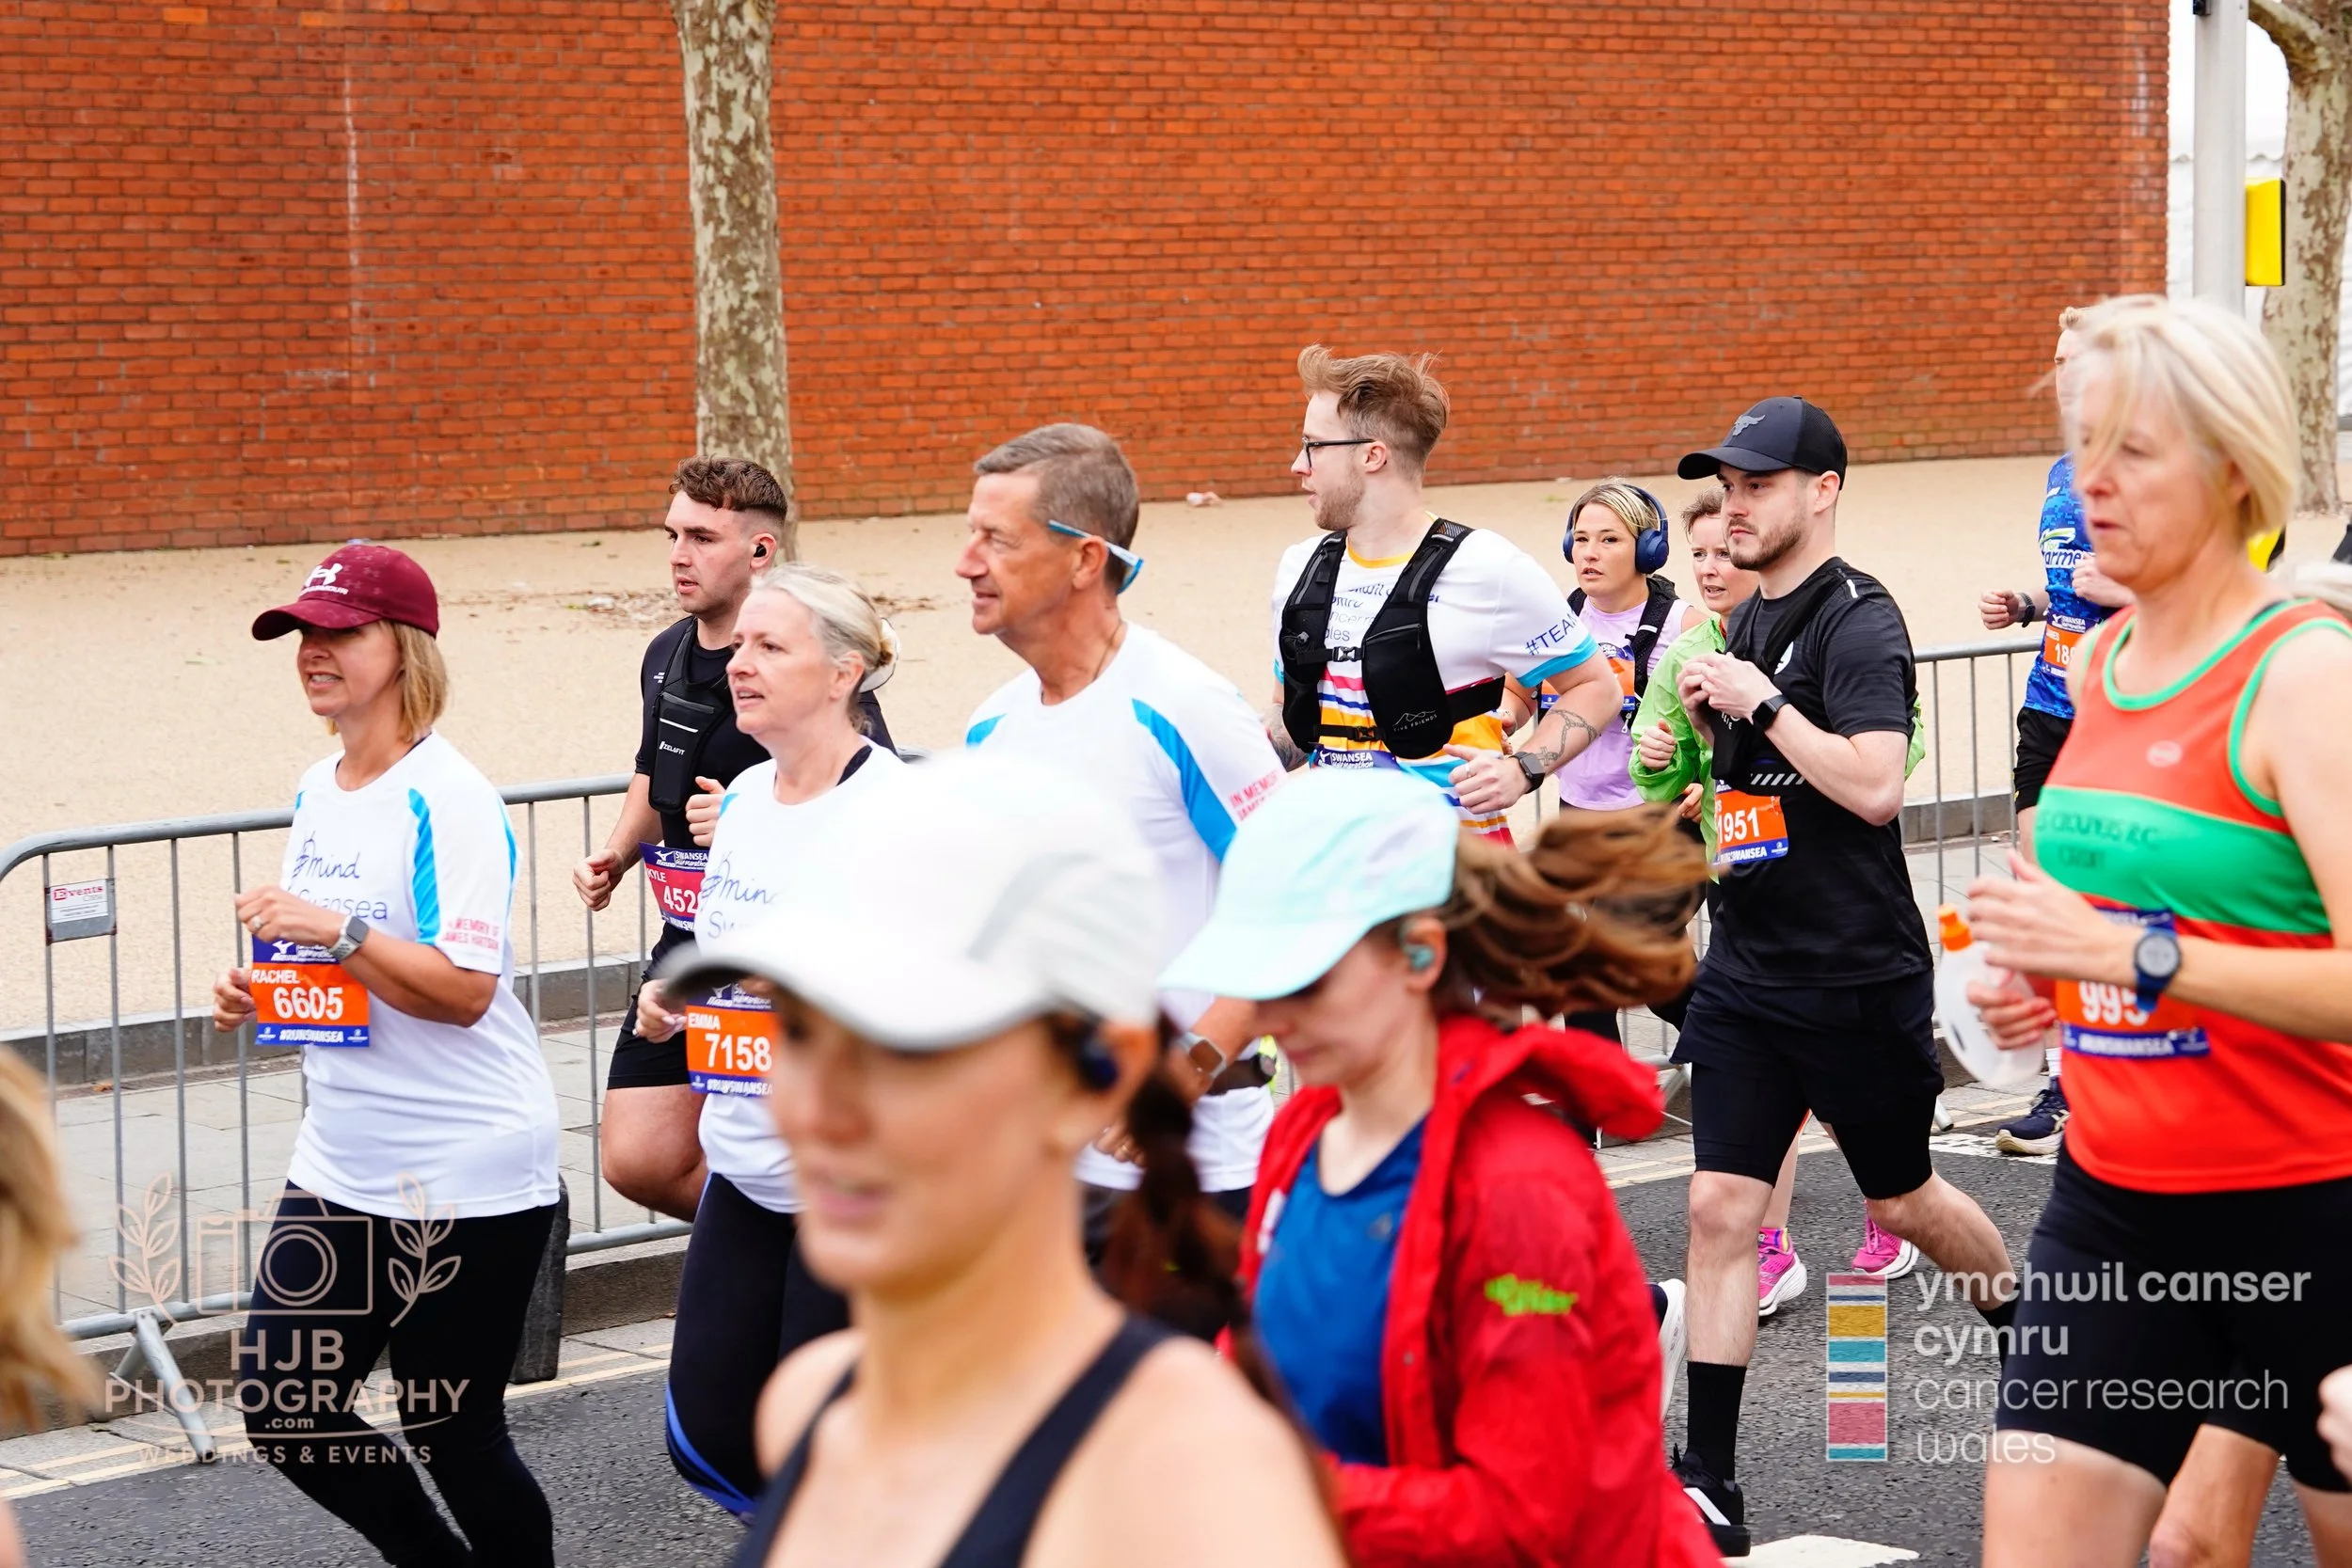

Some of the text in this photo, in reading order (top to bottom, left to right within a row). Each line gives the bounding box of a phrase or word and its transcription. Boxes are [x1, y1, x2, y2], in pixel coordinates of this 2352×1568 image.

[1325, 628, 1350, 641] ales
[1331, 752, 1374, 763] SWANSEA
[675, 850, 708, 861] SWANSEA
[688, 860, 707, 868] Maratho
[646, 867, 667, 883] KYLE
[54, 885, 103, 901] Events
[251, 969, 300, 984] RACHEL
[273, 986, 343, 1021] 6605
[688, 1012, 721, 1030] EMMA
[705, 1033, 772, 1072] 7158
